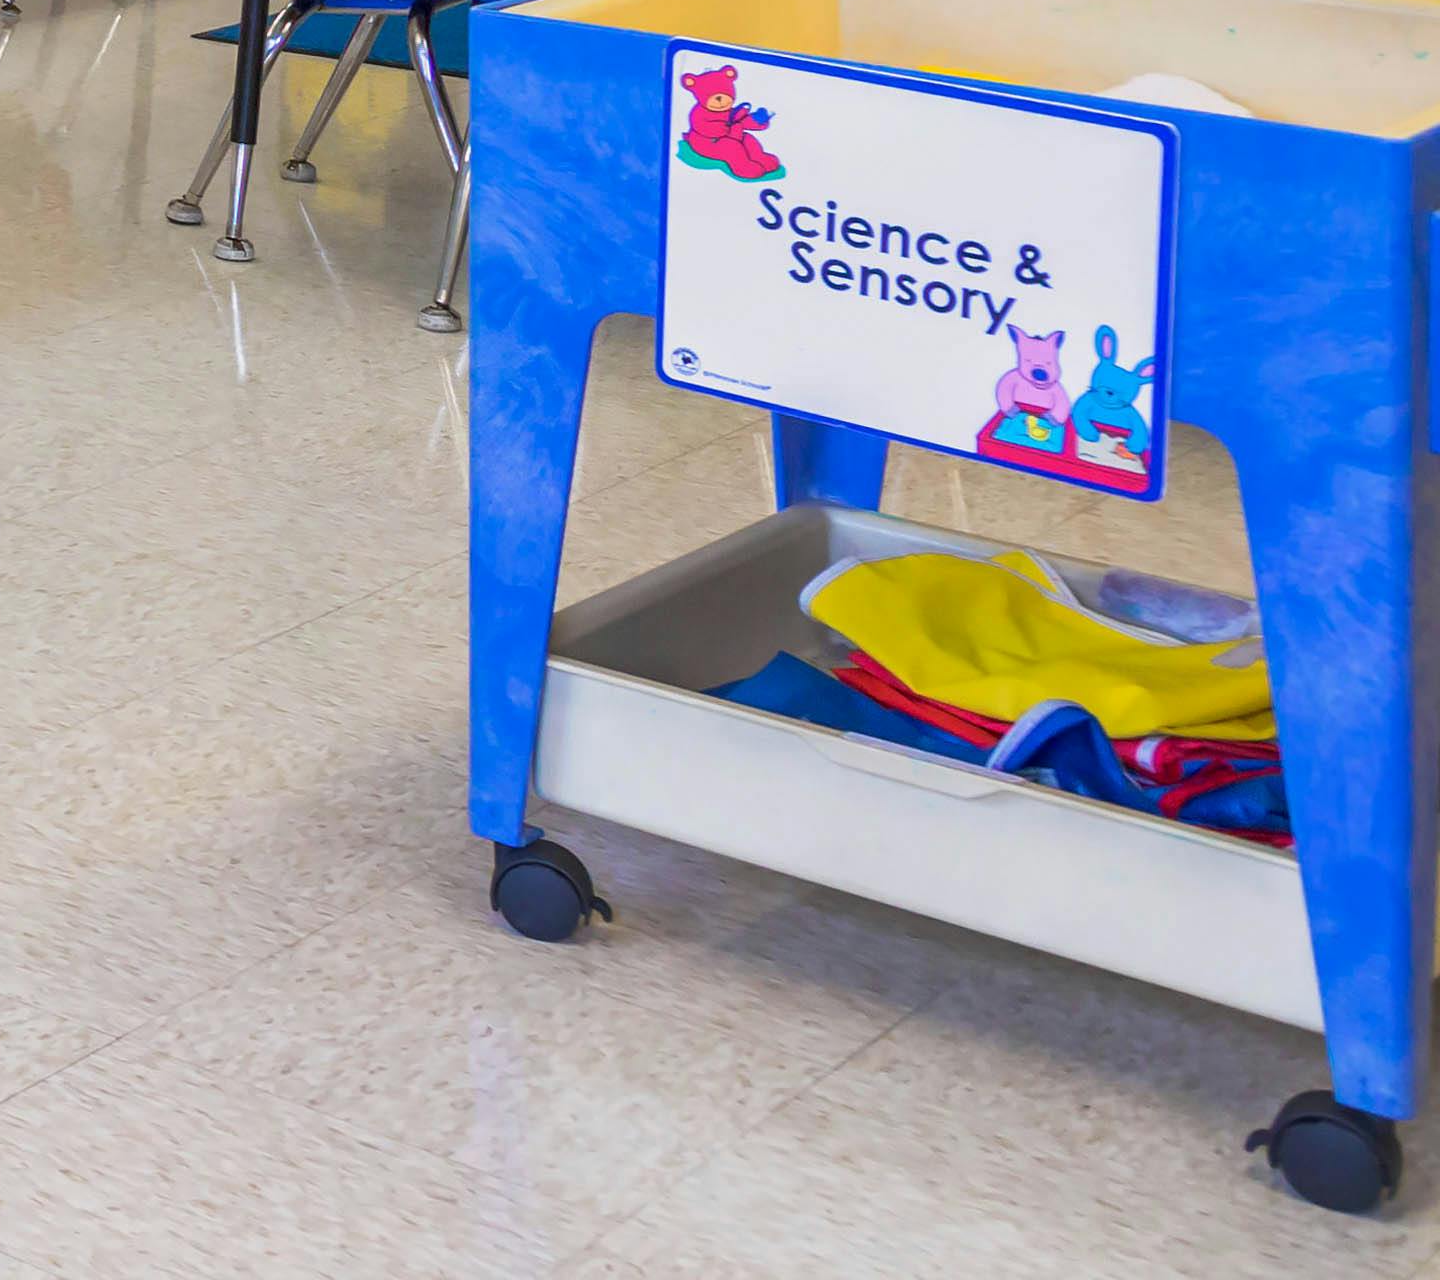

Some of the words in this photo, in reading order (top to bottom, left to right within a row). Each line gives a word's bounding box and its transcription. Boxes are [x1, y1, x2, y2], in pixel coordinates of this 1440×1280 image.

[756, 187, 992, 275] Science
[1013, 243, 1055, 289] &
[787, 241, 1016, 336] Sensory
